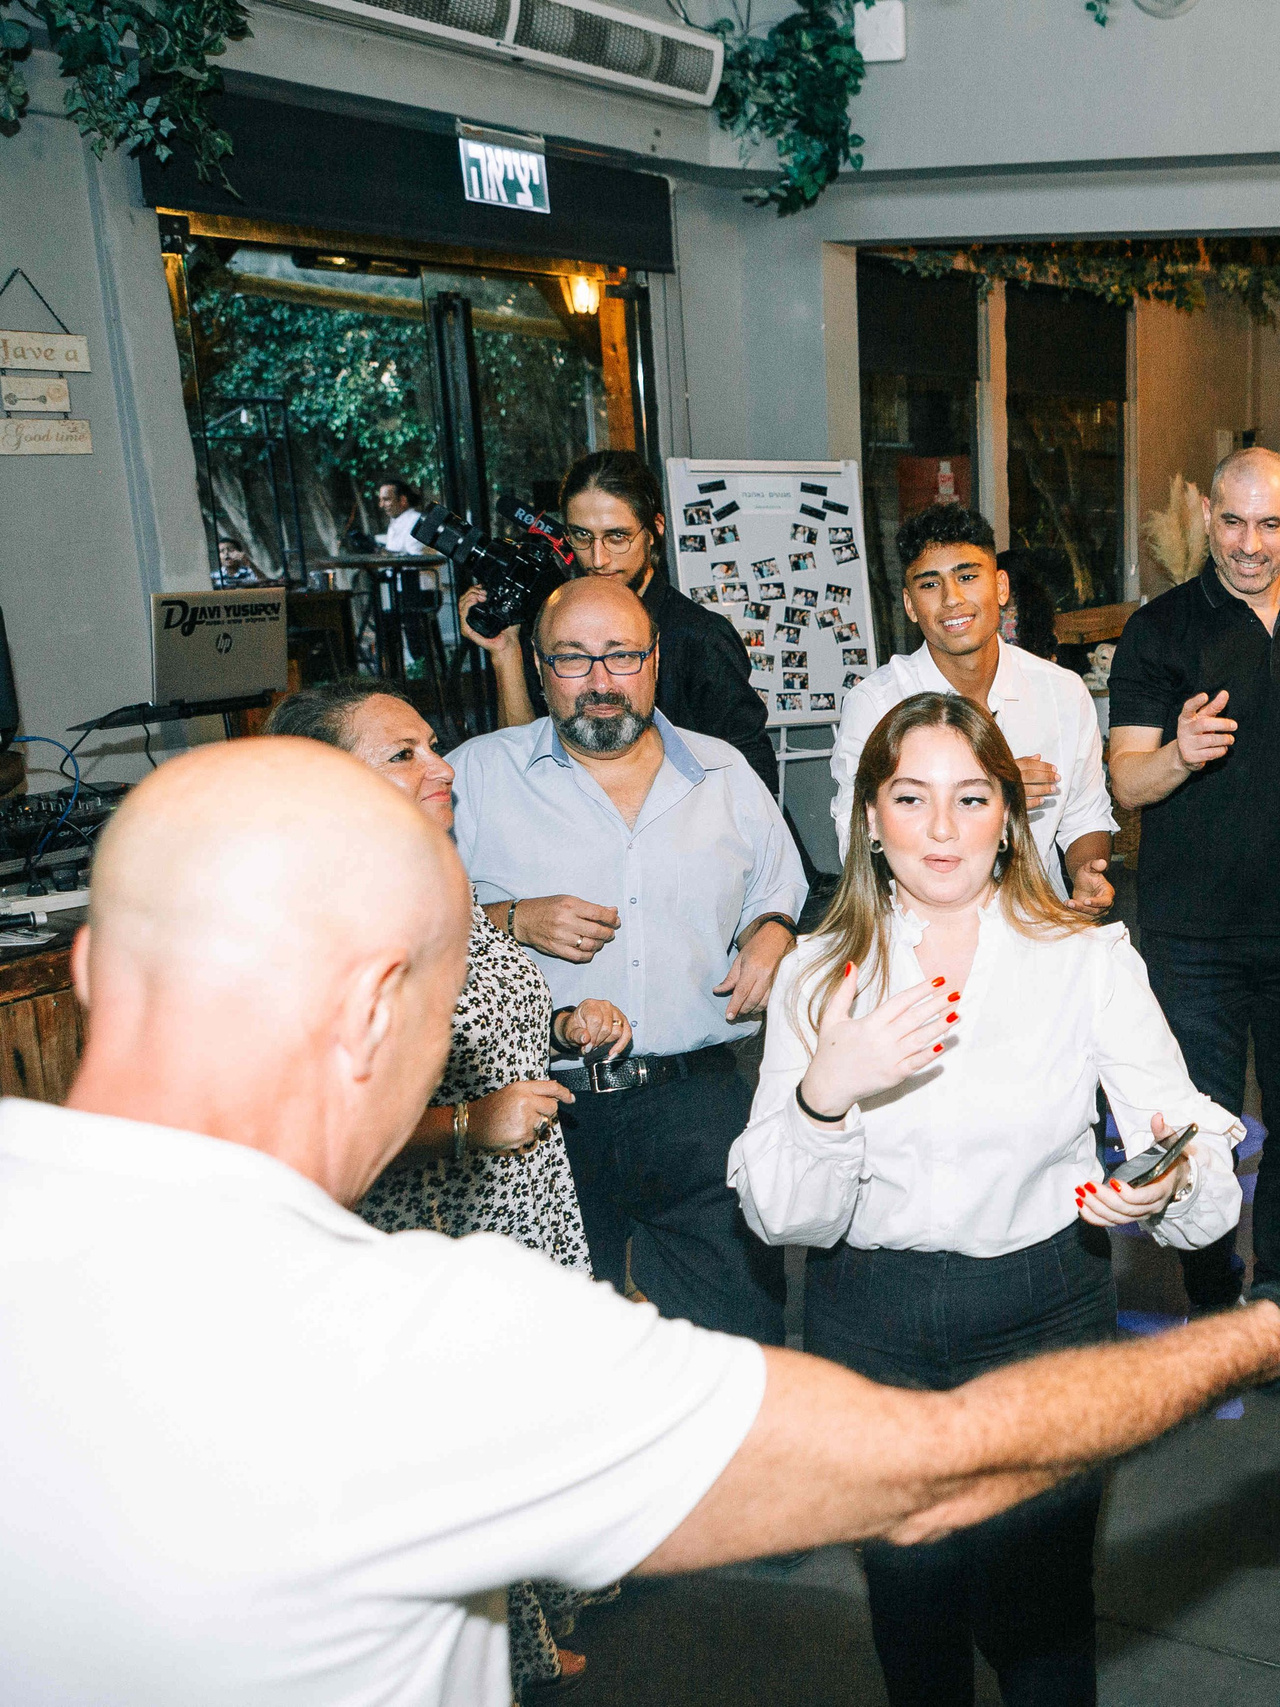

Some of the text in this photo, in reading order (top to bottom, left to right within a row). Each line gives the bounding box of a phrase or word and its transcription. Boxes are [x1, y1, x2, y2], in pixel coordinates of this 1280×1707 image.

[467, 143, 540, 207] יציאה
[64, 348, 79, 362] a
[2, 423, 87, 451] Good time
[216, 632, 233, 655] hp
